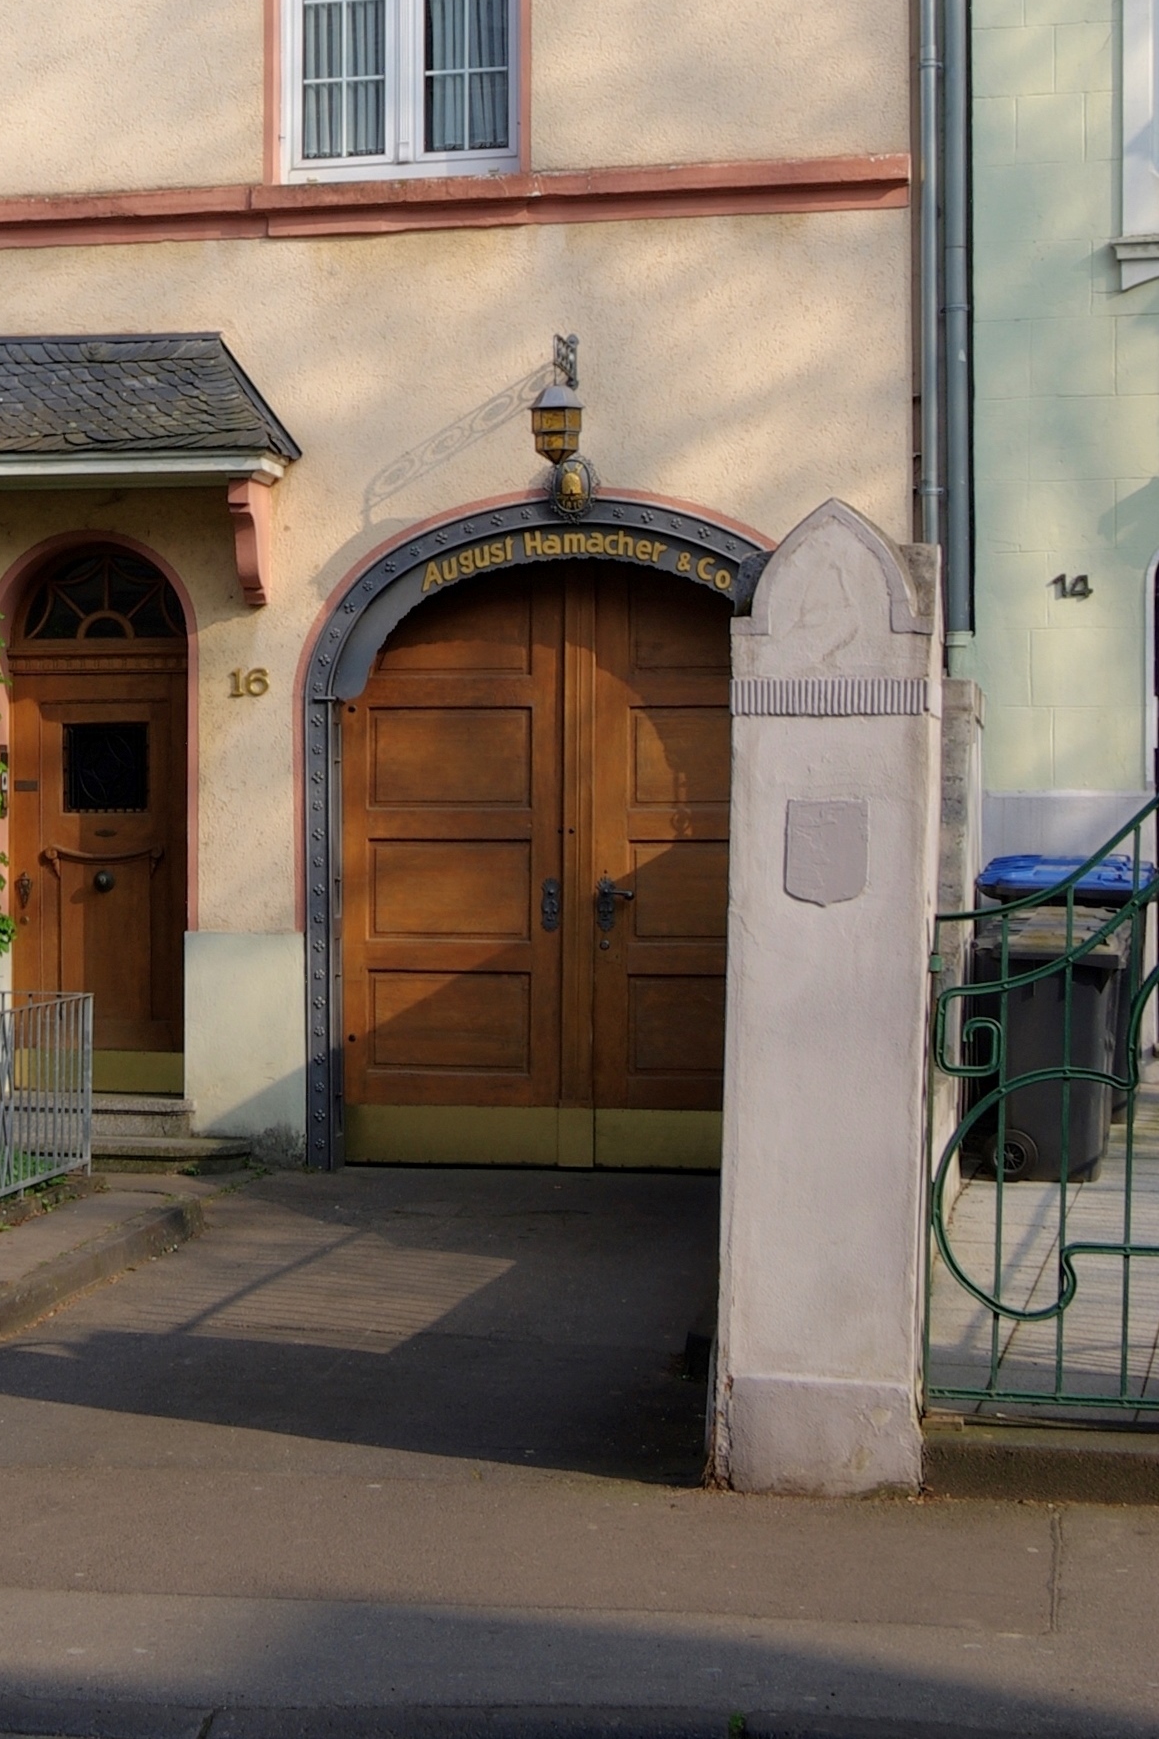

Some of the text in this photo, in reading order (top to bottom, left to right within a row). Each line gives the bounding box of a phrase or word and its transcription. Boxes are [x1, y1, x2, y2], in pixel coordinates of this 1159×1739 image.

[421, 530, 733, 592] August Hamacher & Co.
[1050, 573, 1093, 600] 14
[229, 668, 270, 698] 16
